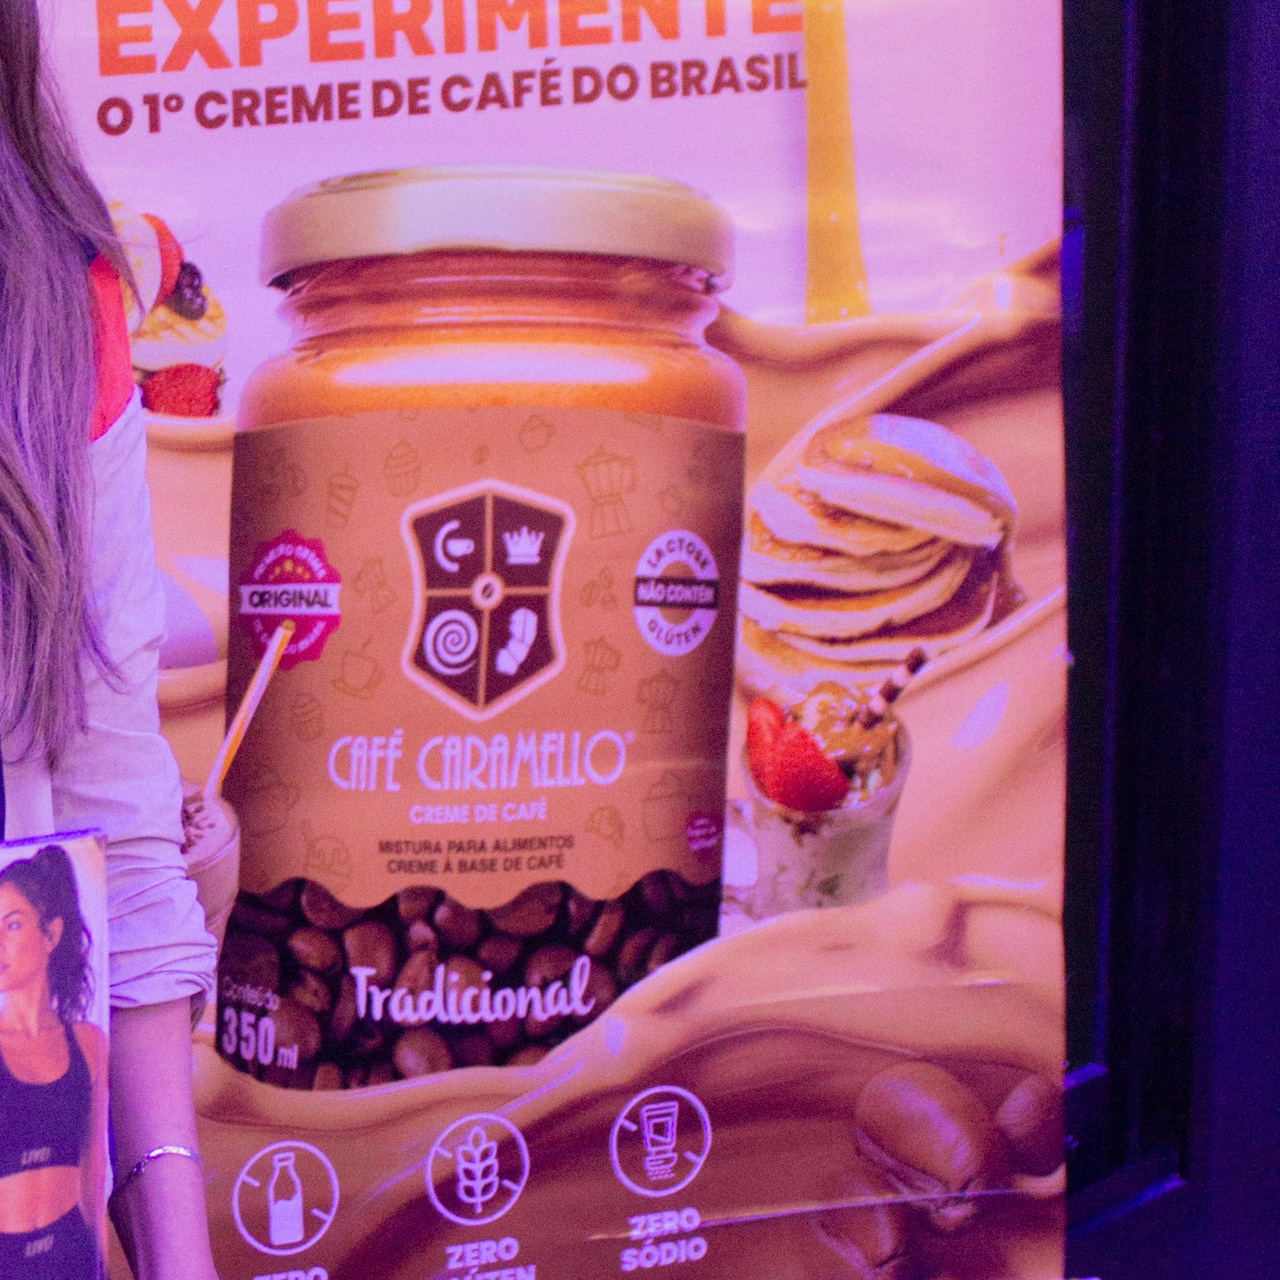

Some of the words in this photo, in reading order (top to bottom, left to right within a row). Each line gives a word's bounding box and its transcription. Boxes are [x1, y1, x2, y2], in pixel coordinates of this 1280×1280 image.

[96, 96, 135, 137] O
[194, 82, 361, 130] CREME
[371, 78, 431, 117] DE
[439, 58, 563, 112] CAFÉ
[570, 63, 639, 105] DO
[649, 51, 808, 100] BRASIL
[248, 590, 332, 609] ORIGINAL
[326, 728, 404, 792] CAFÉ
[416, 729, 626, 792] CARAMELLO
[408, 803, 469, 825] CREME
[474, 802, 498, 823] DE
[501, 796, 548, 822] CAFÉ
[378, 839, 443, 855] MISTURA
[447, 838, 488, 854] PARA
[492, 834, 576, 853] ALIMENTOS
[386, 858, 438, 875] CREME
[457, 857, 499, 874] BASE
[503, 856, 523, 872] DE
[526, 852, 566, 870] CAFÉ
[350, 954, 596, 1024] Tradicional
[221, 1006, 276, 1066] 350
[628, 1206, 702, 1241] ZERO
[445, 1236, 520, 1271] ZERO
[620, 1234, 708, 1272] SÓDIO
